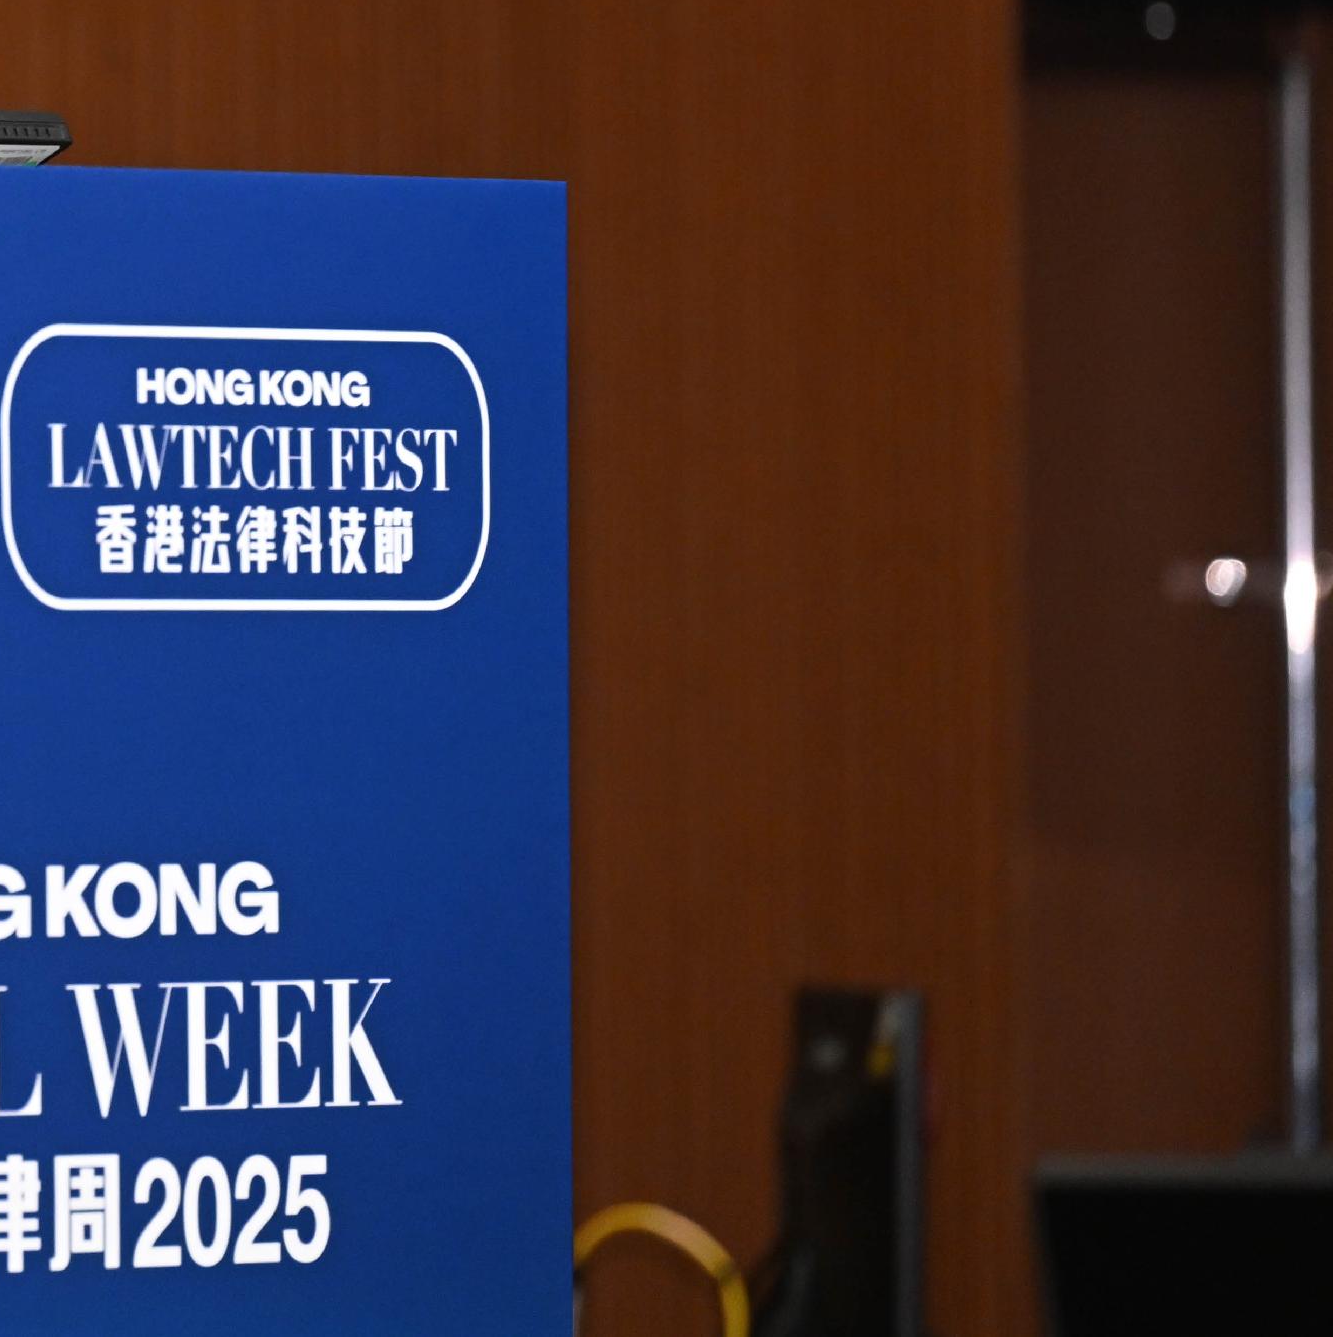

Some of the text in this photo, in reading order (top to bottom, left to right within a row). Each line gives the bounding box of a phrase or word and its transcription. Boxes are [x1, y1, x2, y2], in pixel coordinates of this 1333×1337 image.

[136, 367, 370, 408] HONG KONG
[48, 422, 457, 492] LAWTECH FEST
[96, 504, 413, 574] 香港法律科技節
[45, 861, 279, 938] KONG
[65, 978, 403, 1118] WEEK
